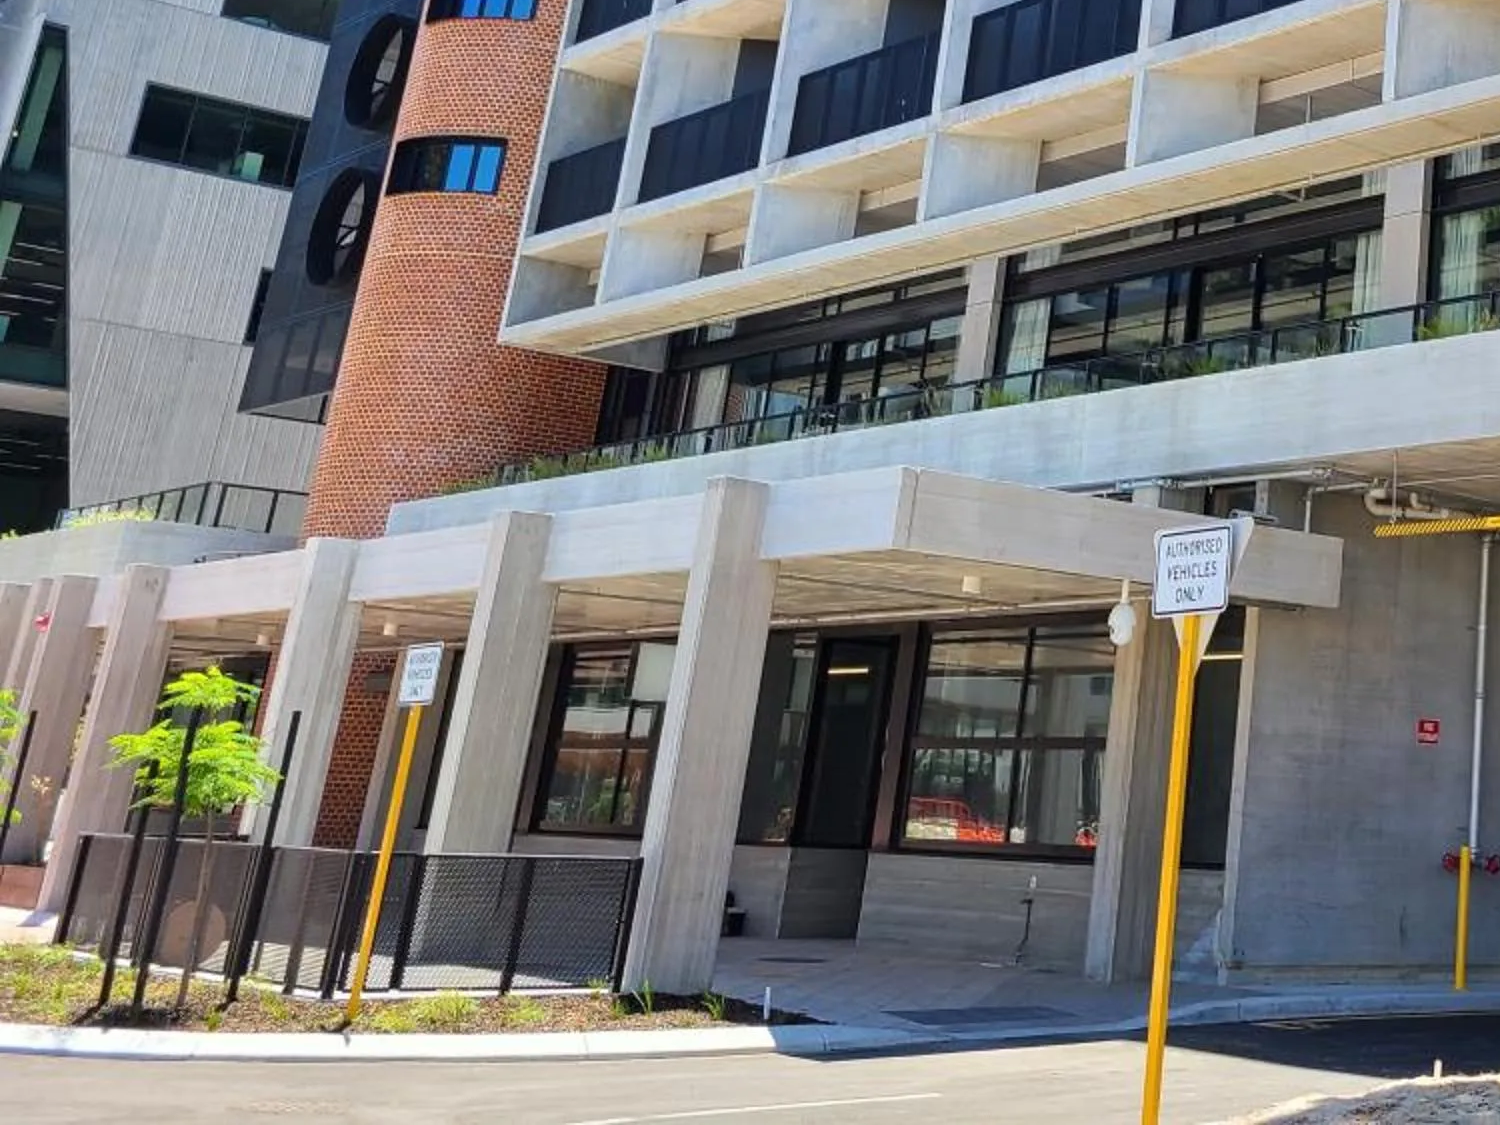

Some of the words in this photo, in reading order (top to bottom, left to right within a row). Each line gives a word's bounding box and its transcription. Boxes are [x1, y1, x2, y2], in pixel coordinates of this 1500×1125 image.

[1166, 536, 1223, 559] AUTHORISED
[1167, 560, 1217, 581] VEHICLES
[1175, 585, 1205, 604] ONLY
